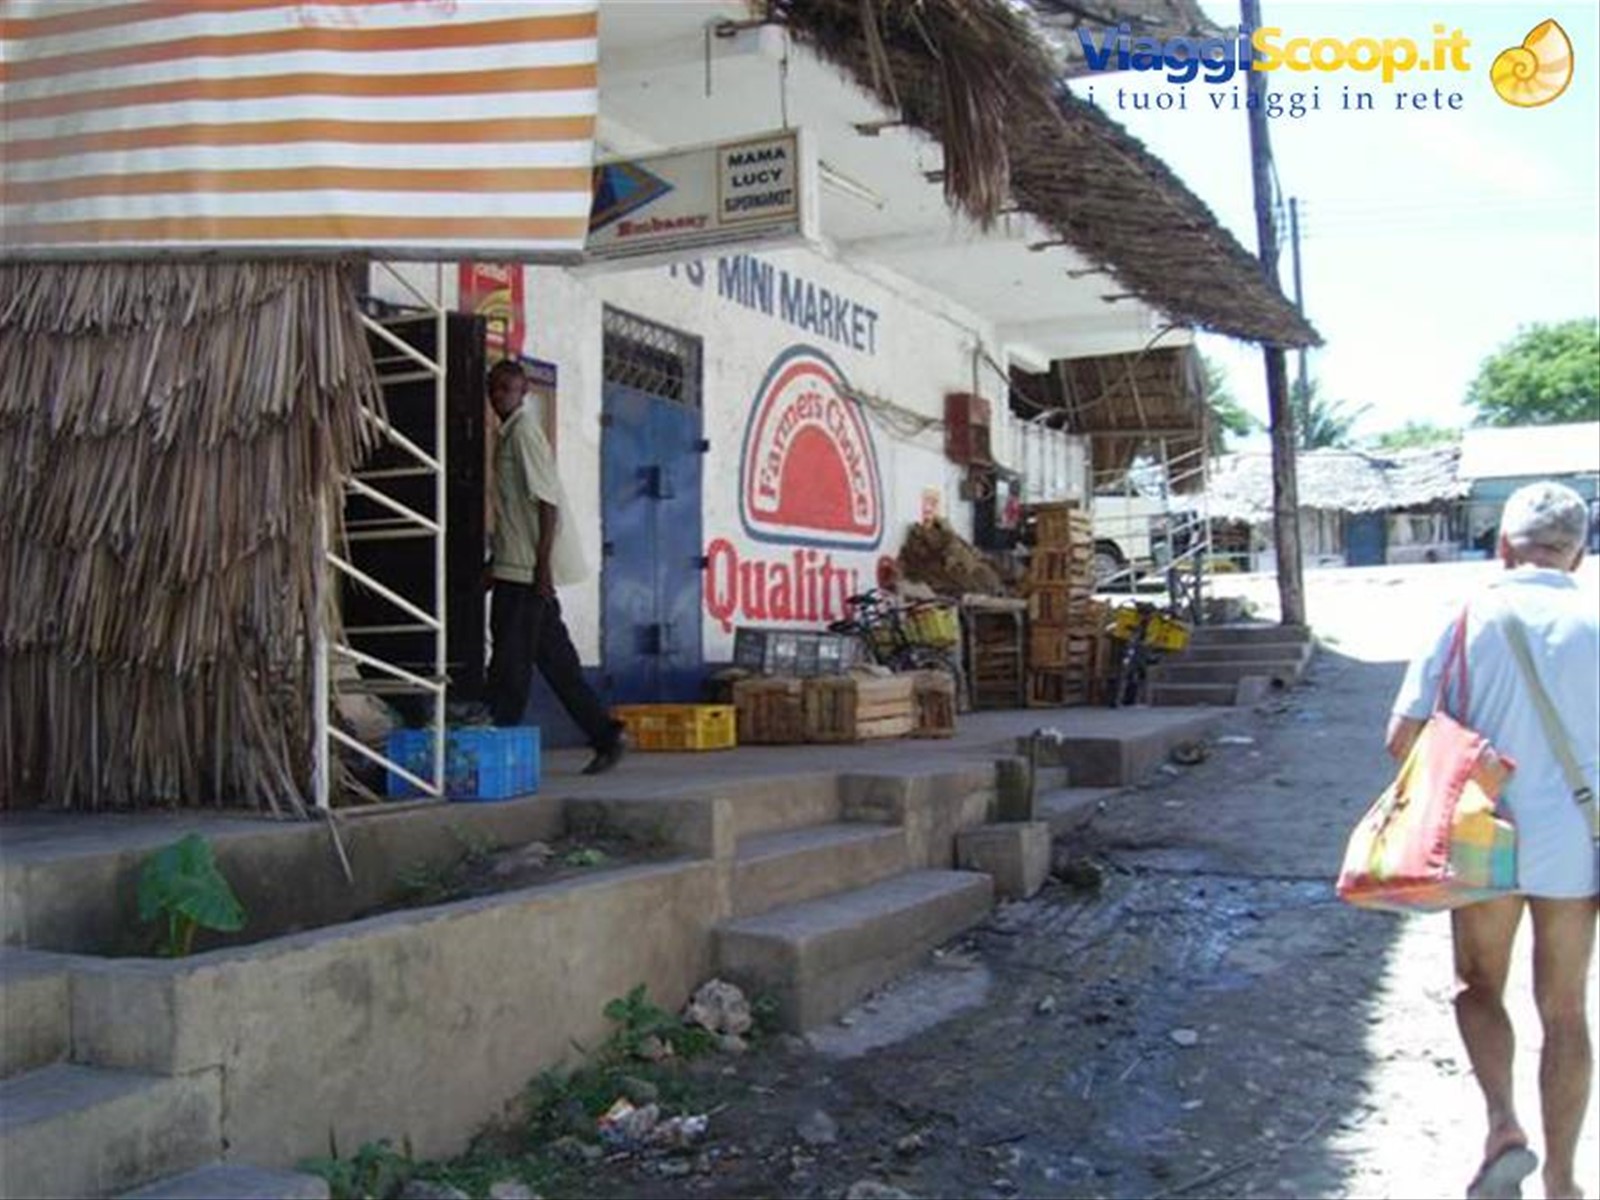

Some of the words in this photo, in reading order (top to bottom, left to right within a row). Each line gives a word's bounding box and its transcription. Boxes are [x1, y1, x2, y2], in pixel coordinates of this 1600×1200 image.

[728, 147, 786, 168] MAMA
[731, 168, 783, 188] LUCY
[717, 255, 775, 317] MINI
[779, 270, 879, 355] MARKET
[704, 537, 859, 634] Quality
